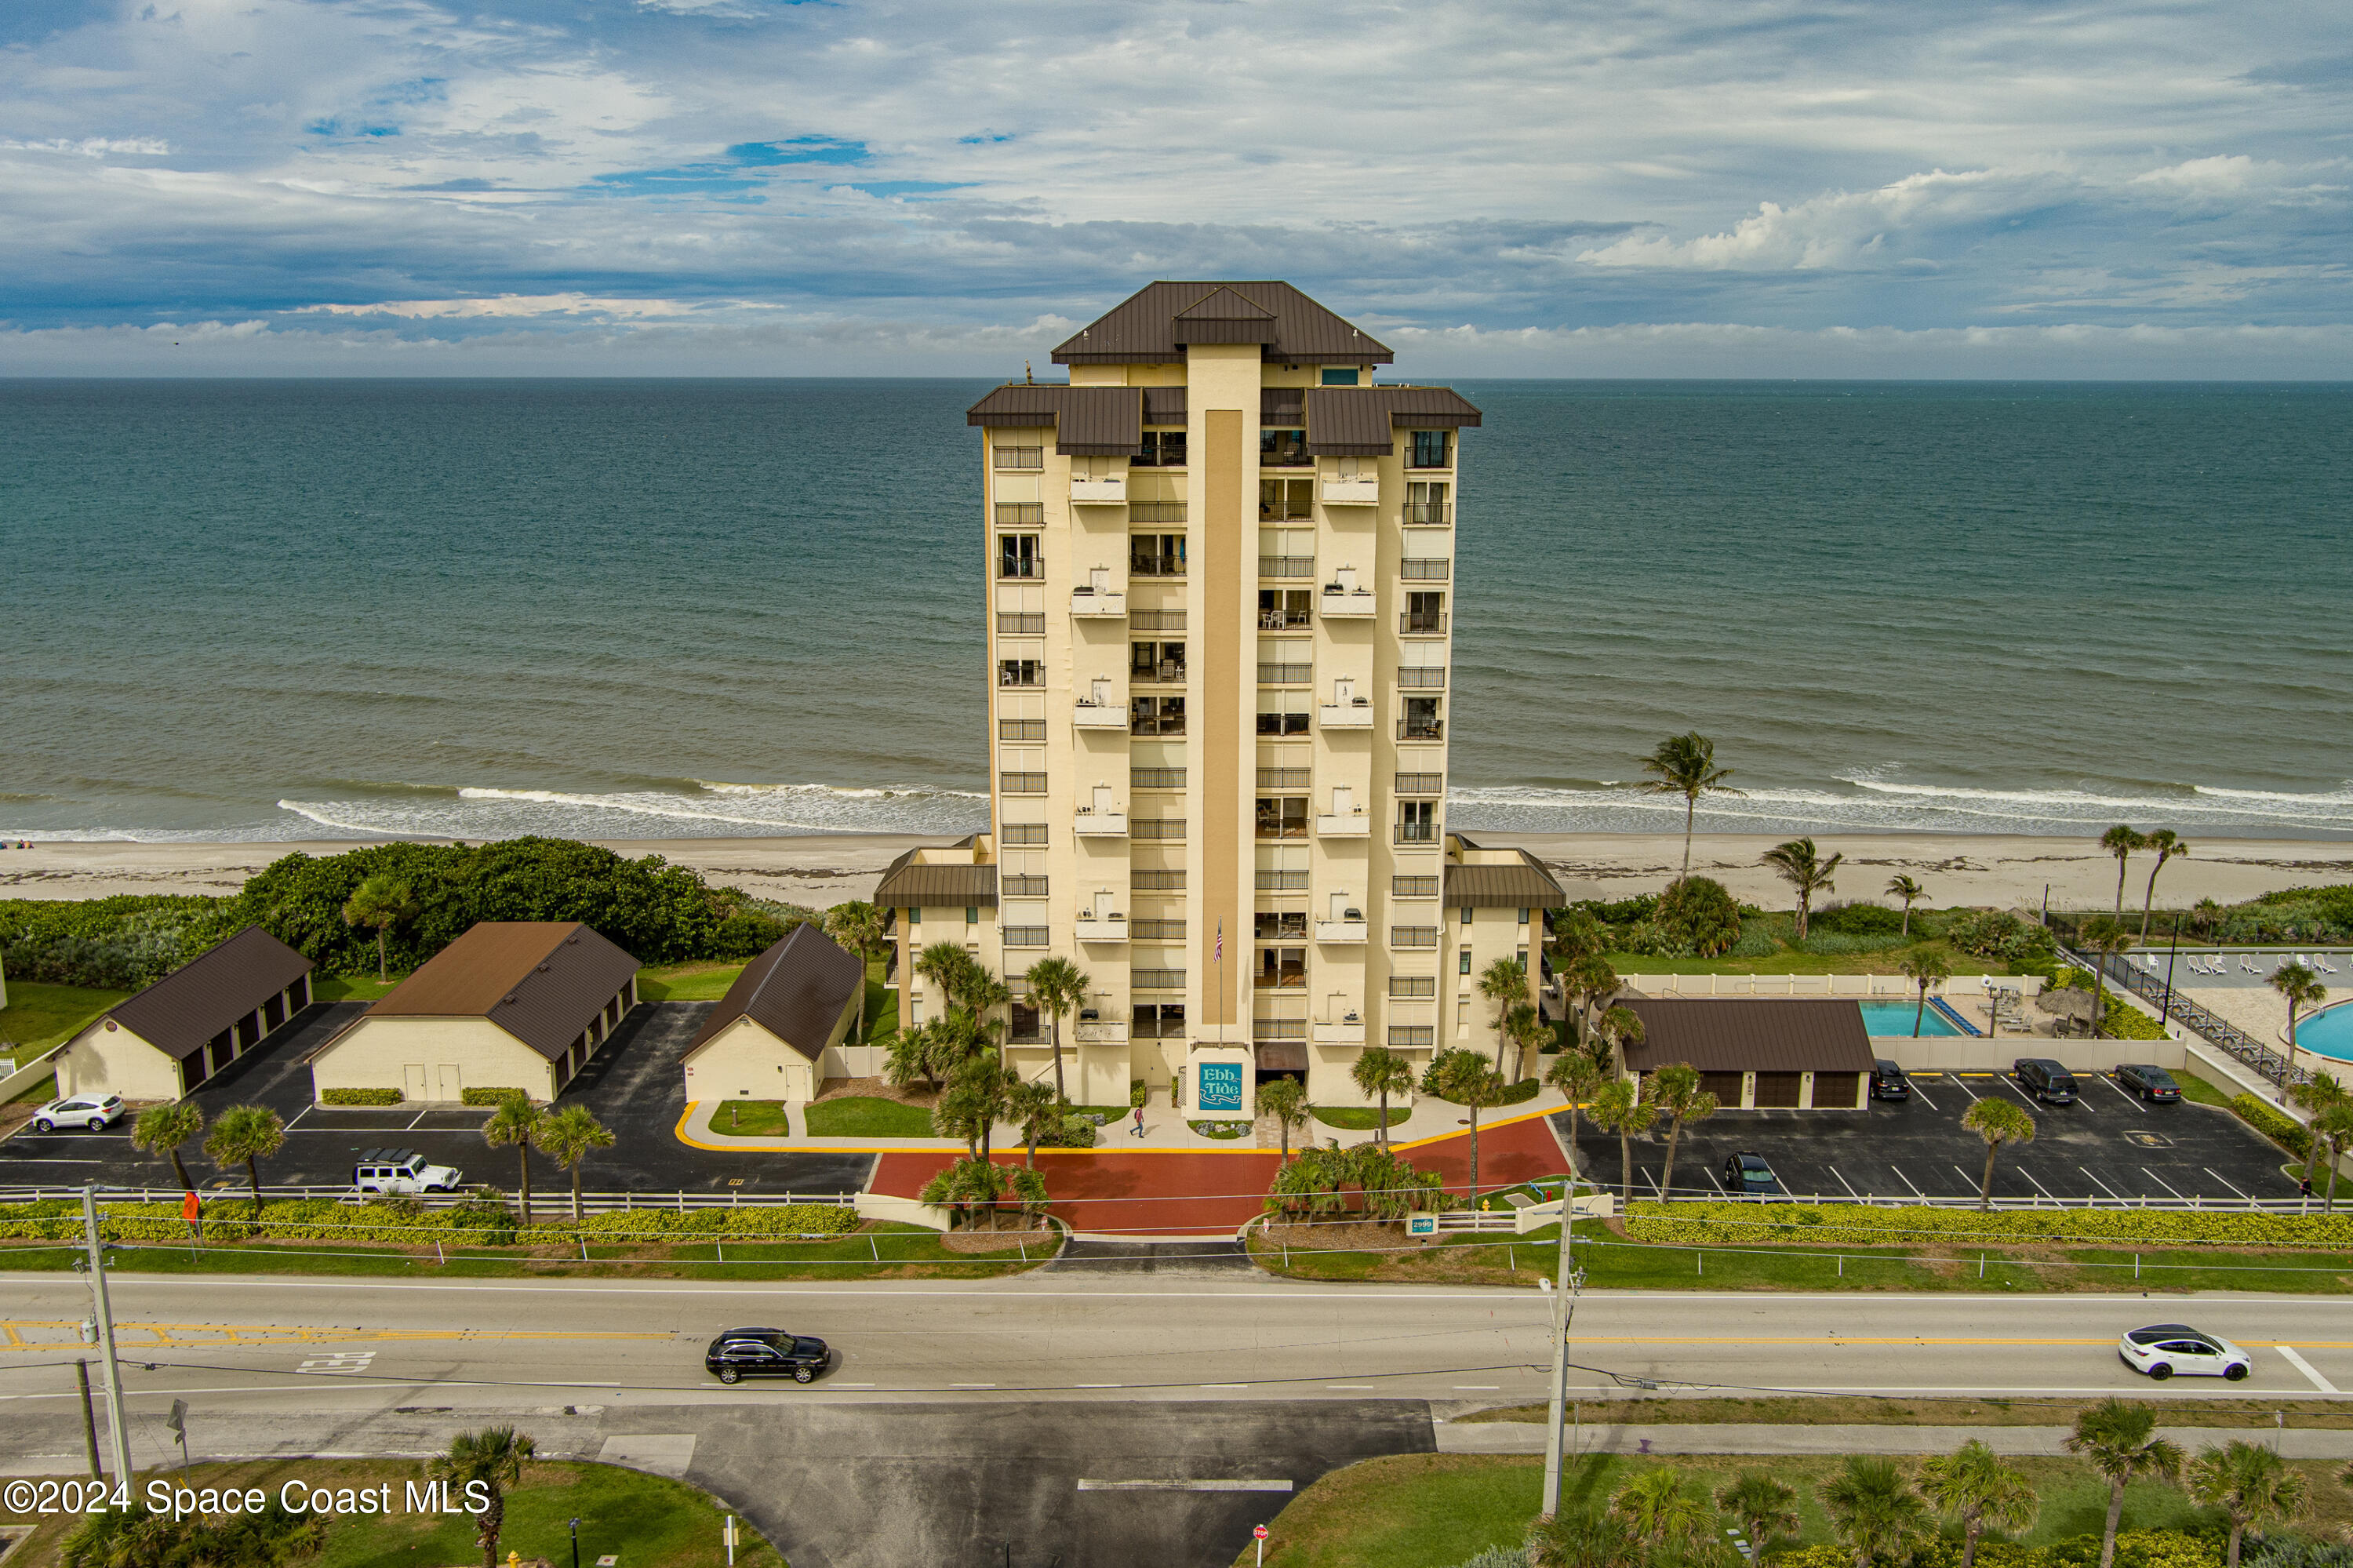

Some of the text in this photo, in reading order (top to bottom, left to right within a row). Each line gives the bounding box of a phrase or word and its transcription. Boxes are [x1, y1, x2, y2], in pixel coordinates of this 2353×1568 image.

[1203, 1068, 1235, 1081] Ebb
[1204, 1082, 1239, 1094] Tide
[295, 1351, 377, 1373] PED
